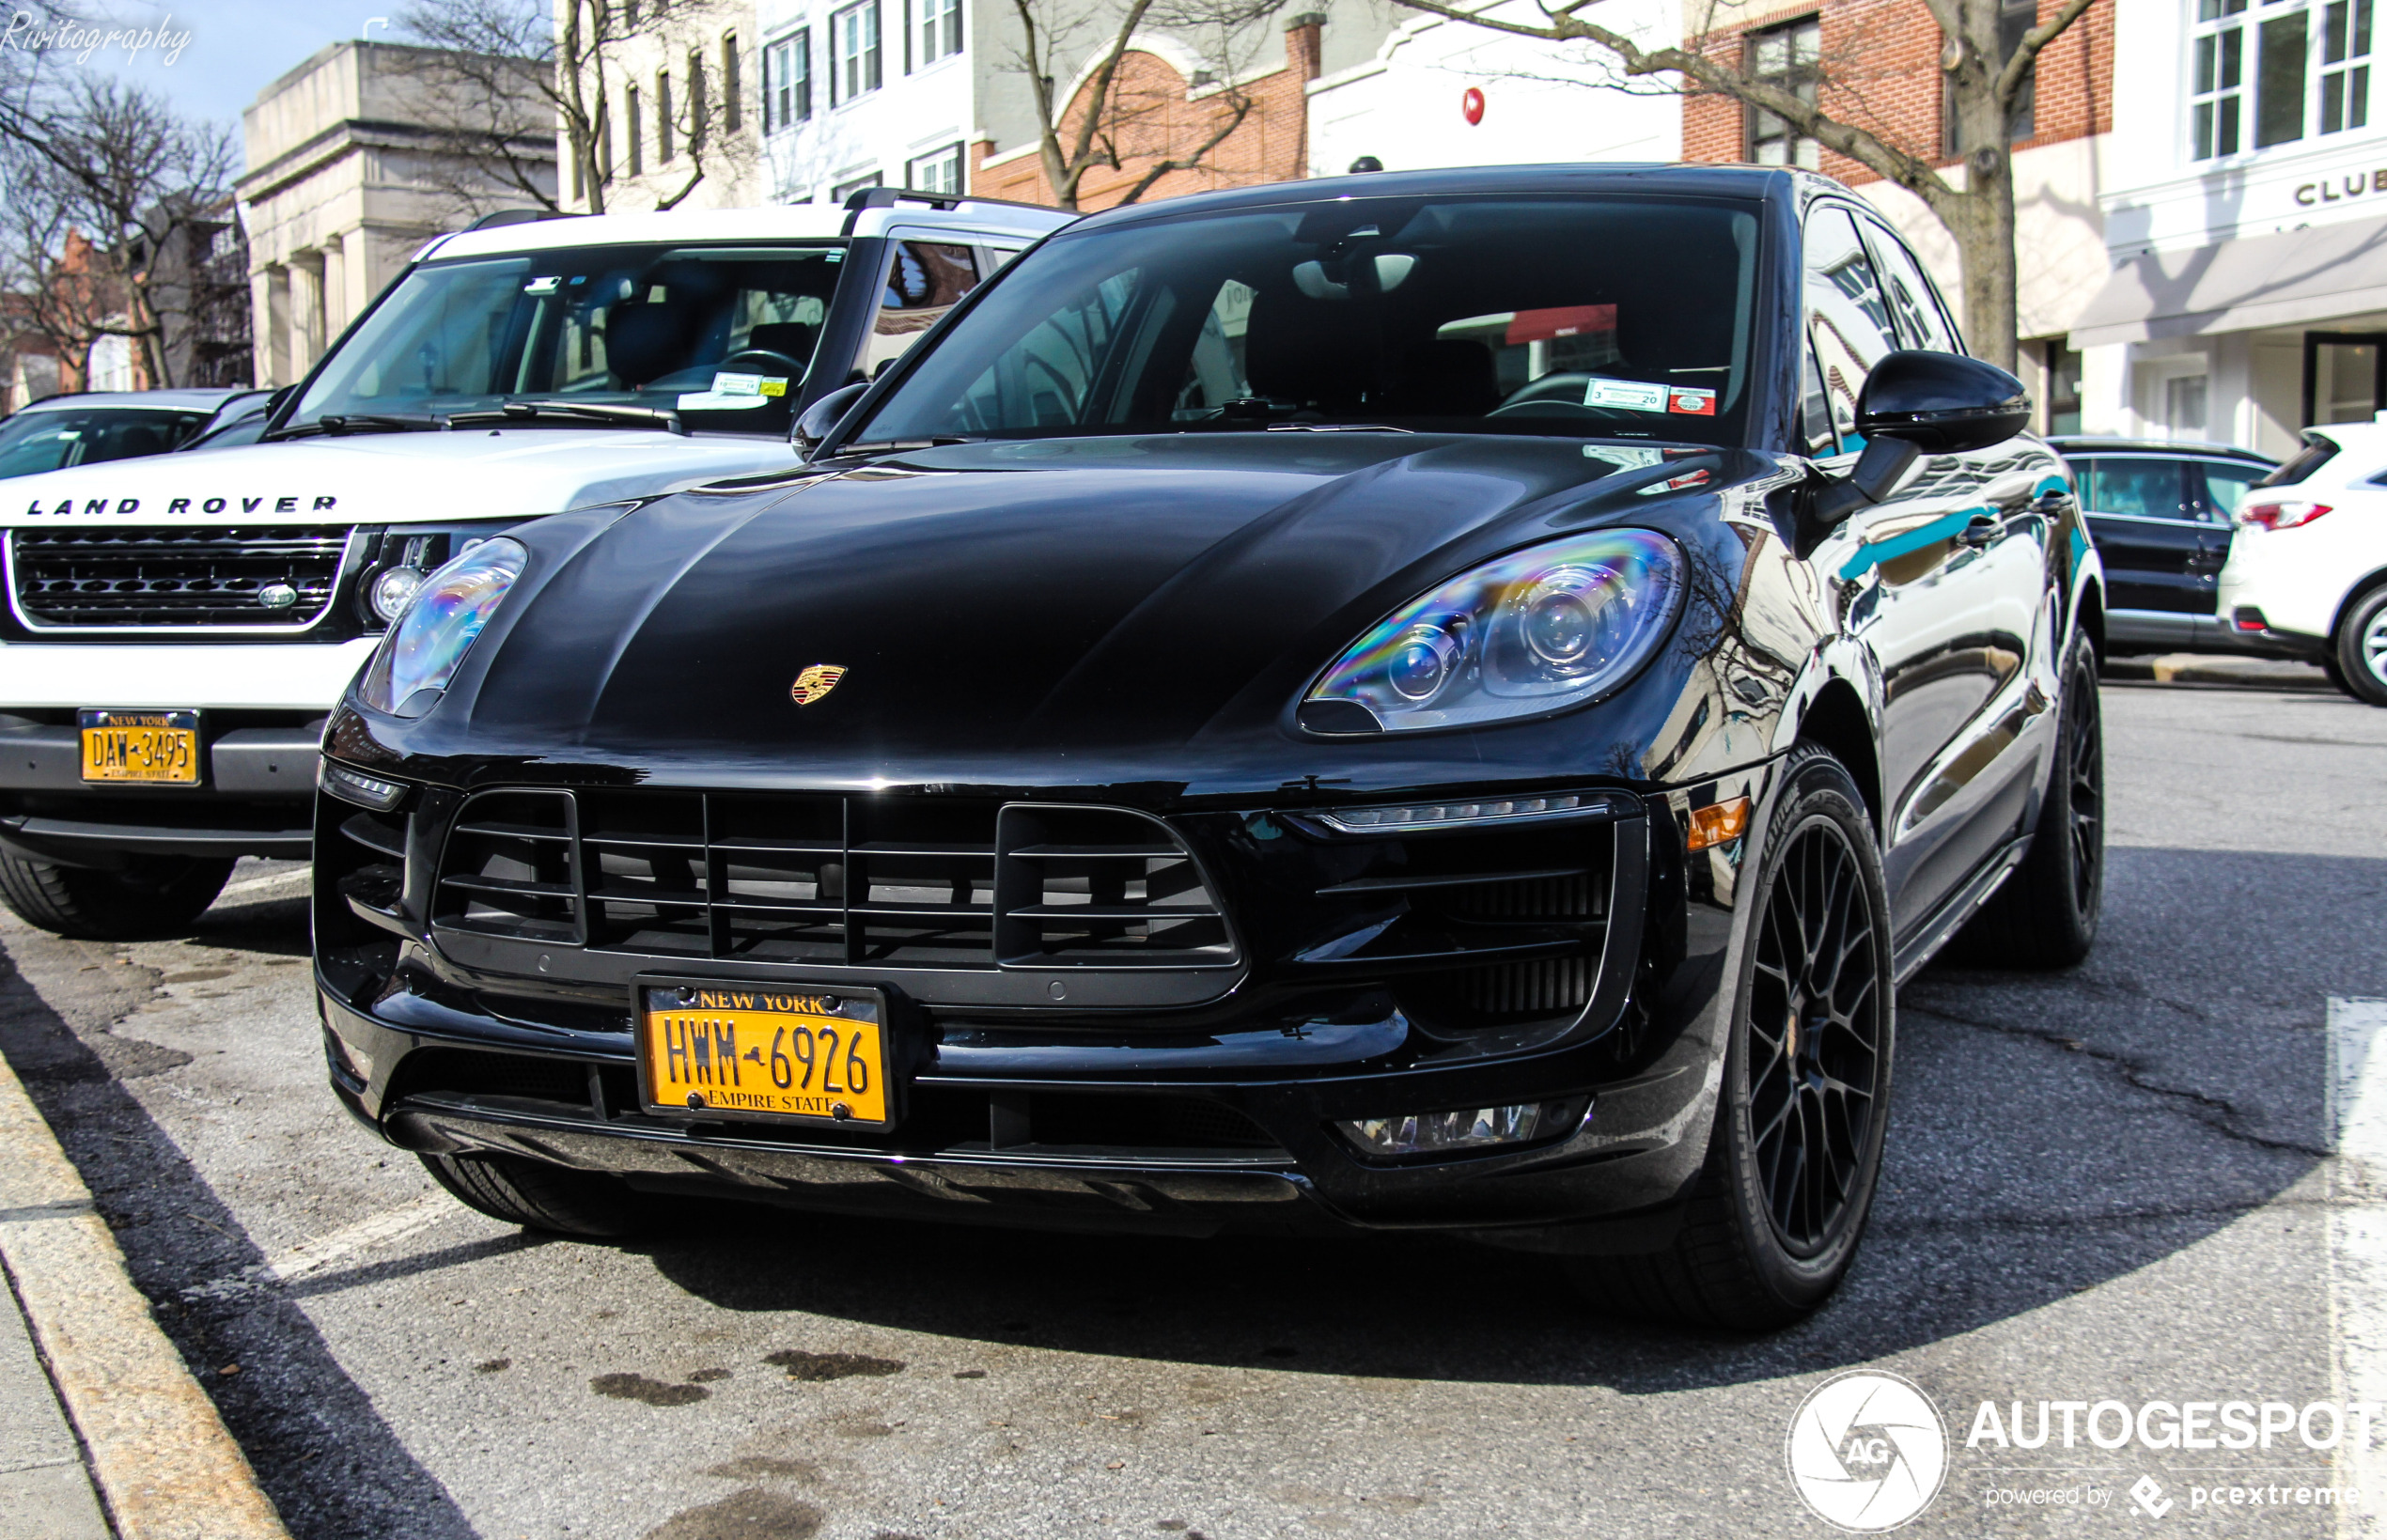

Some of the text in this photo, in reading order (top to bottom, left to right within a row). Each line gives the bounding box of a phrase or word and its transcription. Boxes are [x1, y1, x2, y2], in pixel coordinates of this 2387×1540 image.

[2294, 170, 2387, 206] CLUB
[1594, 391, 1602, 399] 3
[1642, 396, 1658, 404] 20
[27, 496, 336, 514] LAND ROVER
[109, 716, 170, 726] NEW YORK
[700, 990, 827, 1015] NEW YORK
[709, 1090, 834, 1112] EMPIRE STATE
